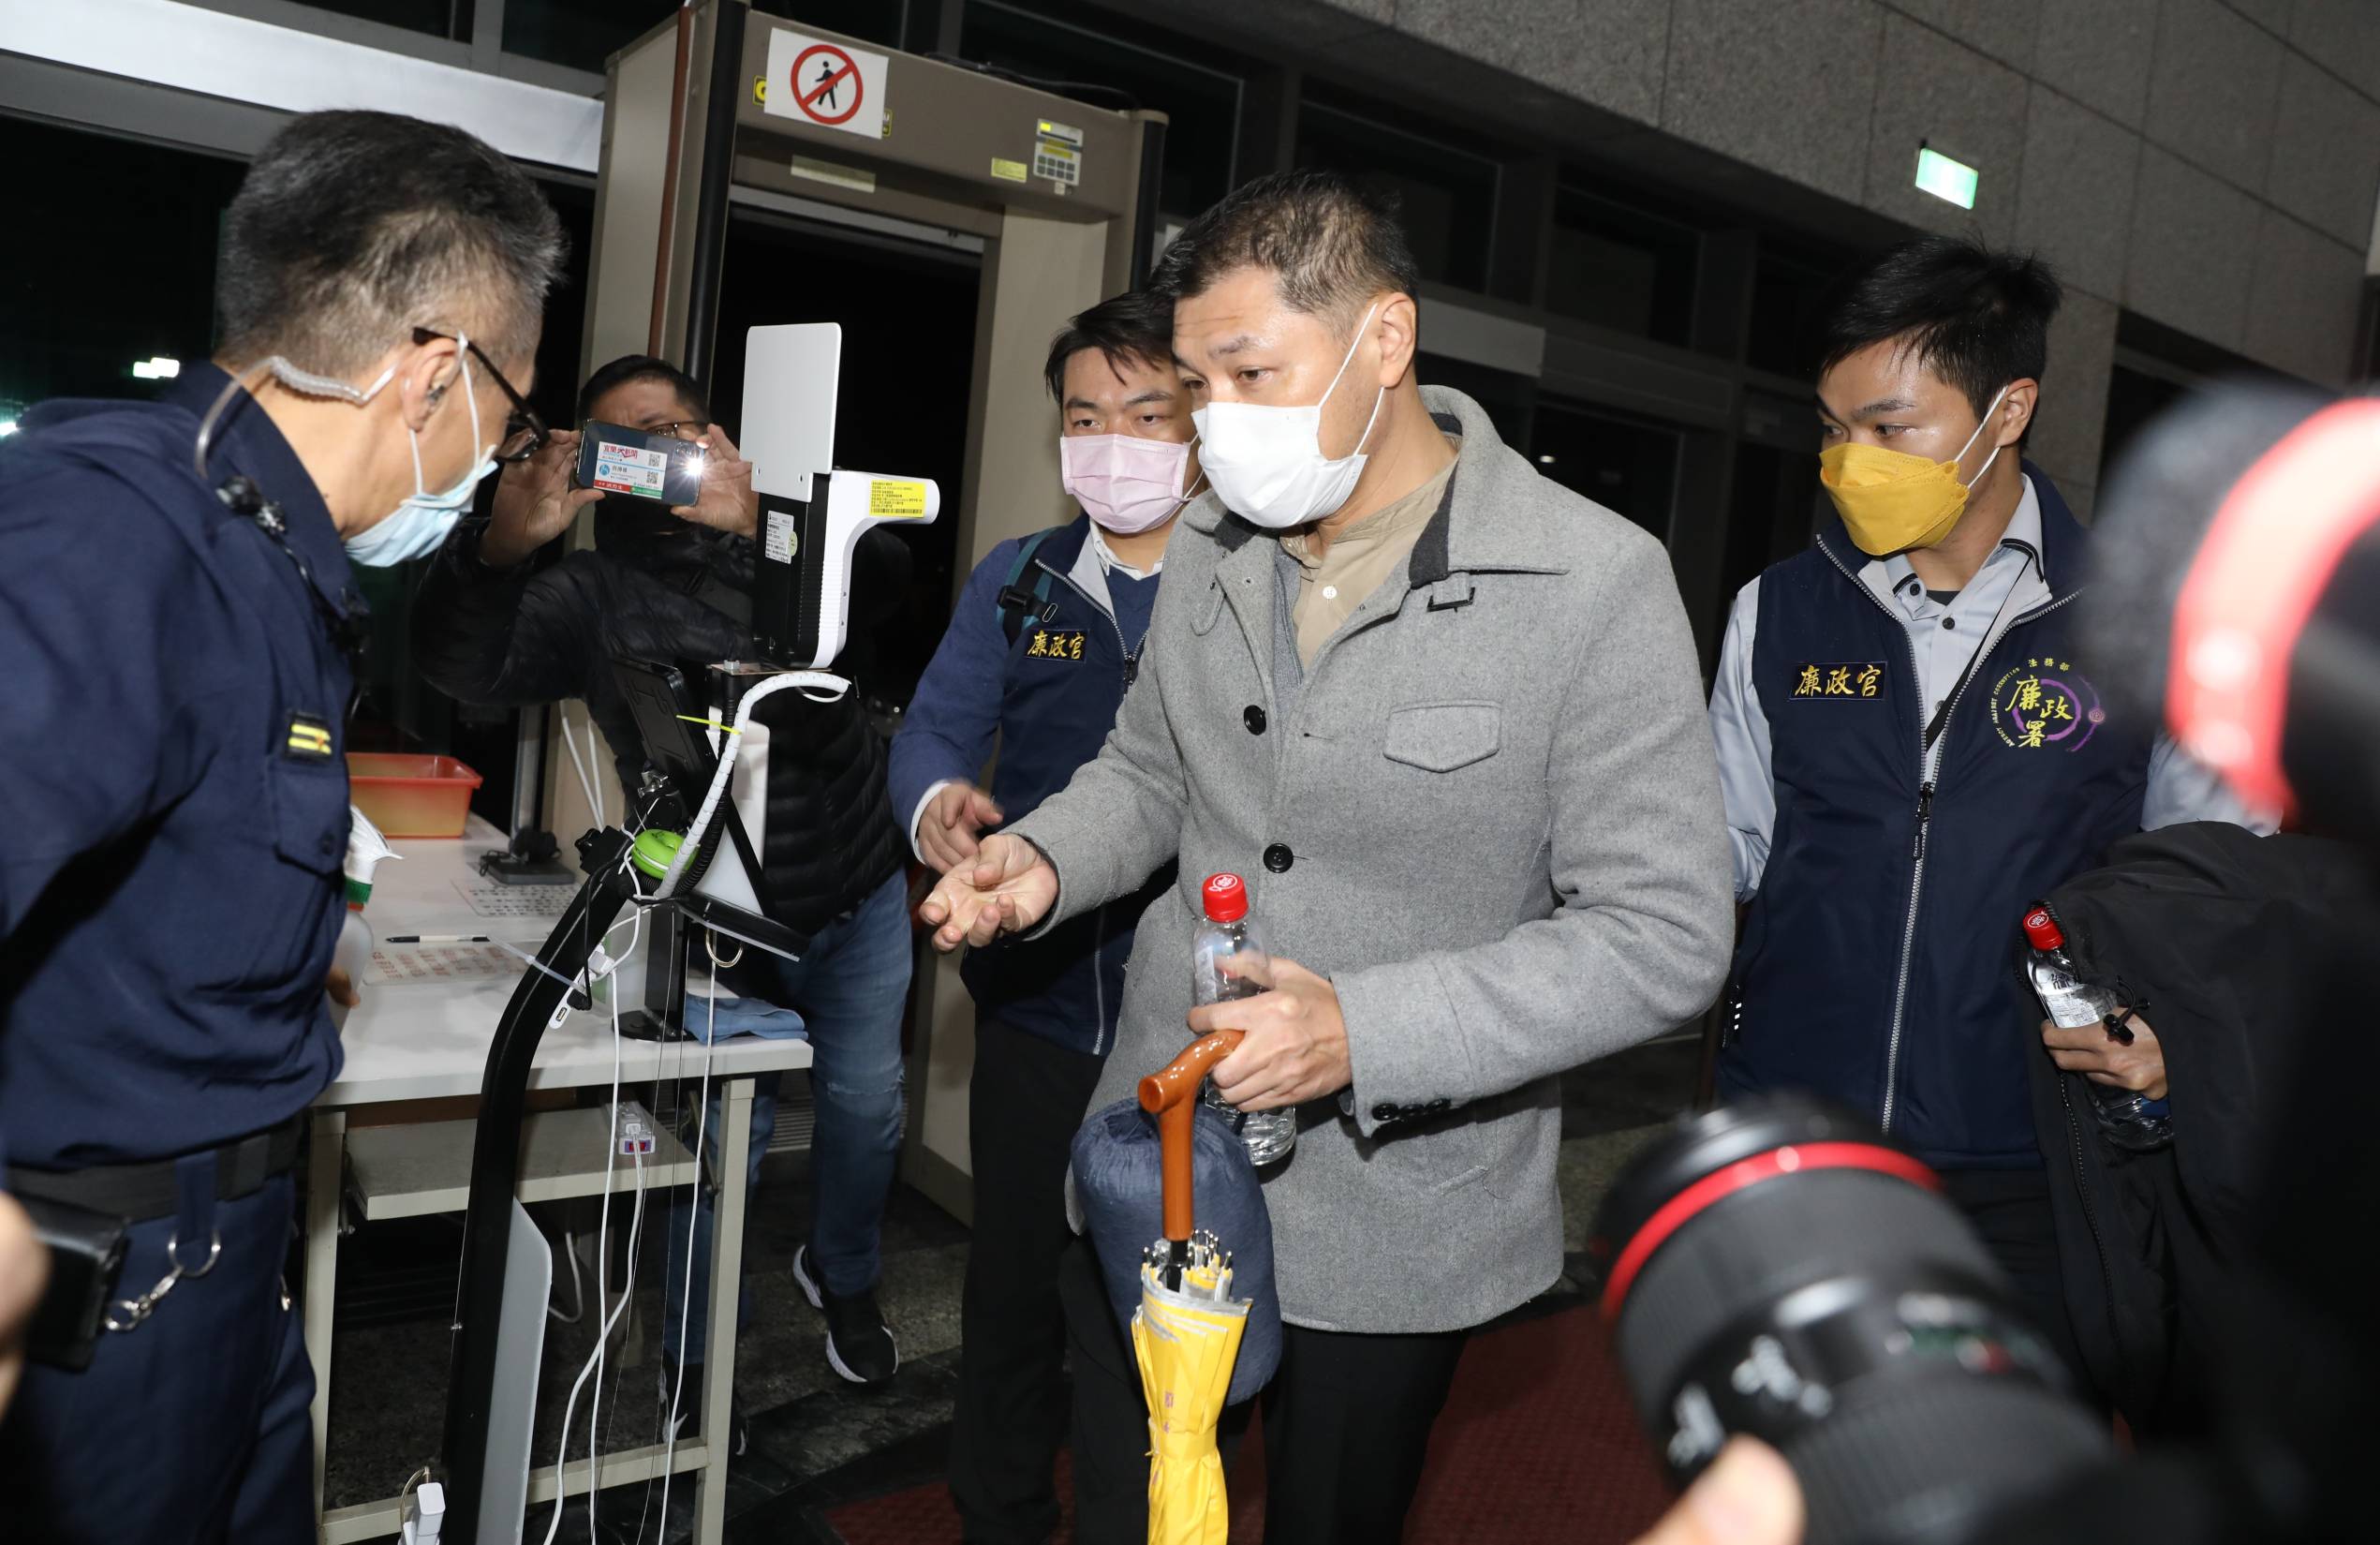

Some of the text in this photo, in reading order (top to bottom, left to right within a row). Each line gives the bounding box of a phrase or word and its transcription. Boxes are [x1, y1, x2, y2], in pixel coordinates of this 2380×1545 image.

[1027, 630, 1085, 660] 廉政官
[1795, 664, 1881, 697] 廉政官
[2028, 658, 2070, 672] 法務部
[2004, 675, 2074, 748] 廉政署
